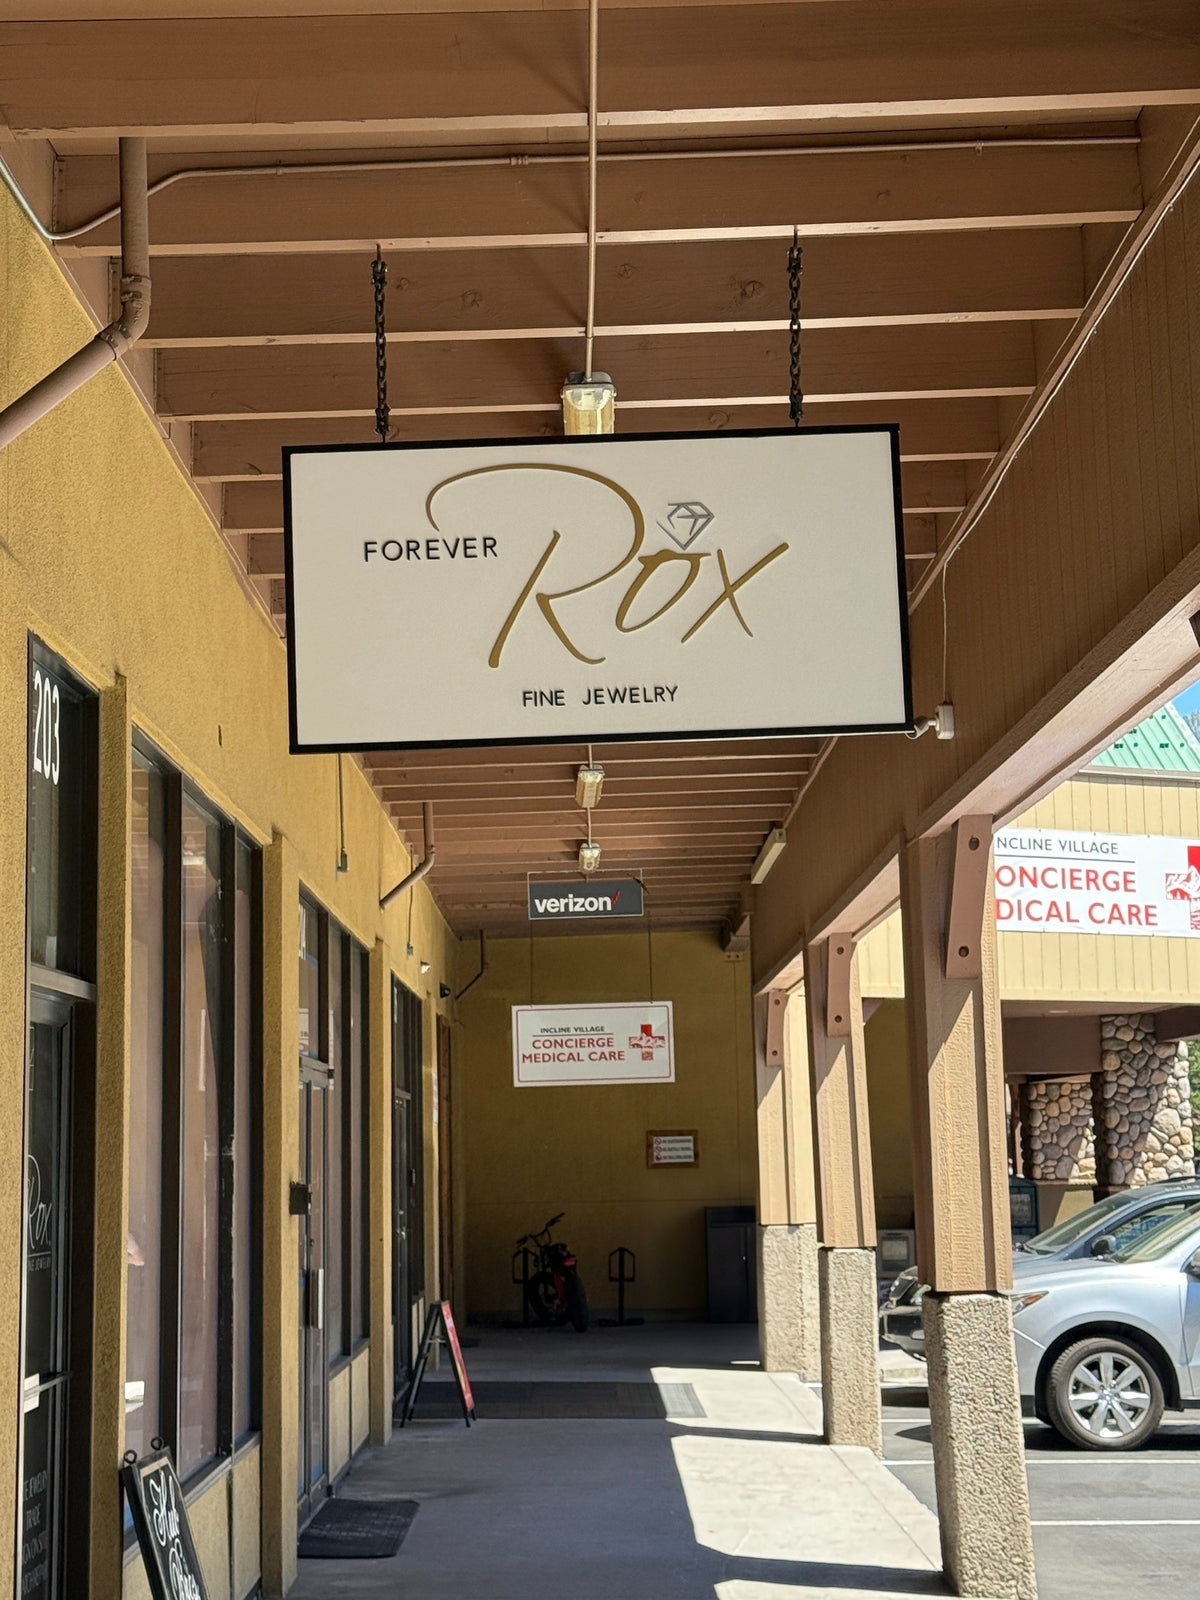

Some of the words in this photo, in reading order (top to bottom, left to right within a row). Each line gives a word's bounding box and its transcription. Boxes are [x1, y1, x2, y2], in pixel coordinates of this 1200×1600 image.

[364, 536, 498, 562] FOREVER
[426, 463, 789, 669] Rox
[522, 690, 566, 707] FINE
[582, 685, 678, 705] JEWELRY
[33, 670, 60, 785] 203
[996, 837, 1053, 851] NCLINE
[1058, 839, 1119, 855] VILLAGE
[995, 865, 1137, 893] ONCIERGE
[534, 893, 612, 913] verizon
[995, 899, 1080, 923] DICAL
[1088, 902, 1158, 926] CARE
[540, 1026, 571, 1034] INCLINE
[574, 1025, 605, 1033] VILLAGE
[532, 1037, 615, 1050] CONCIERGE
[522, 1051, 584, 1064] MEDICAL
[588, 1050, 625, 1062] CARE
